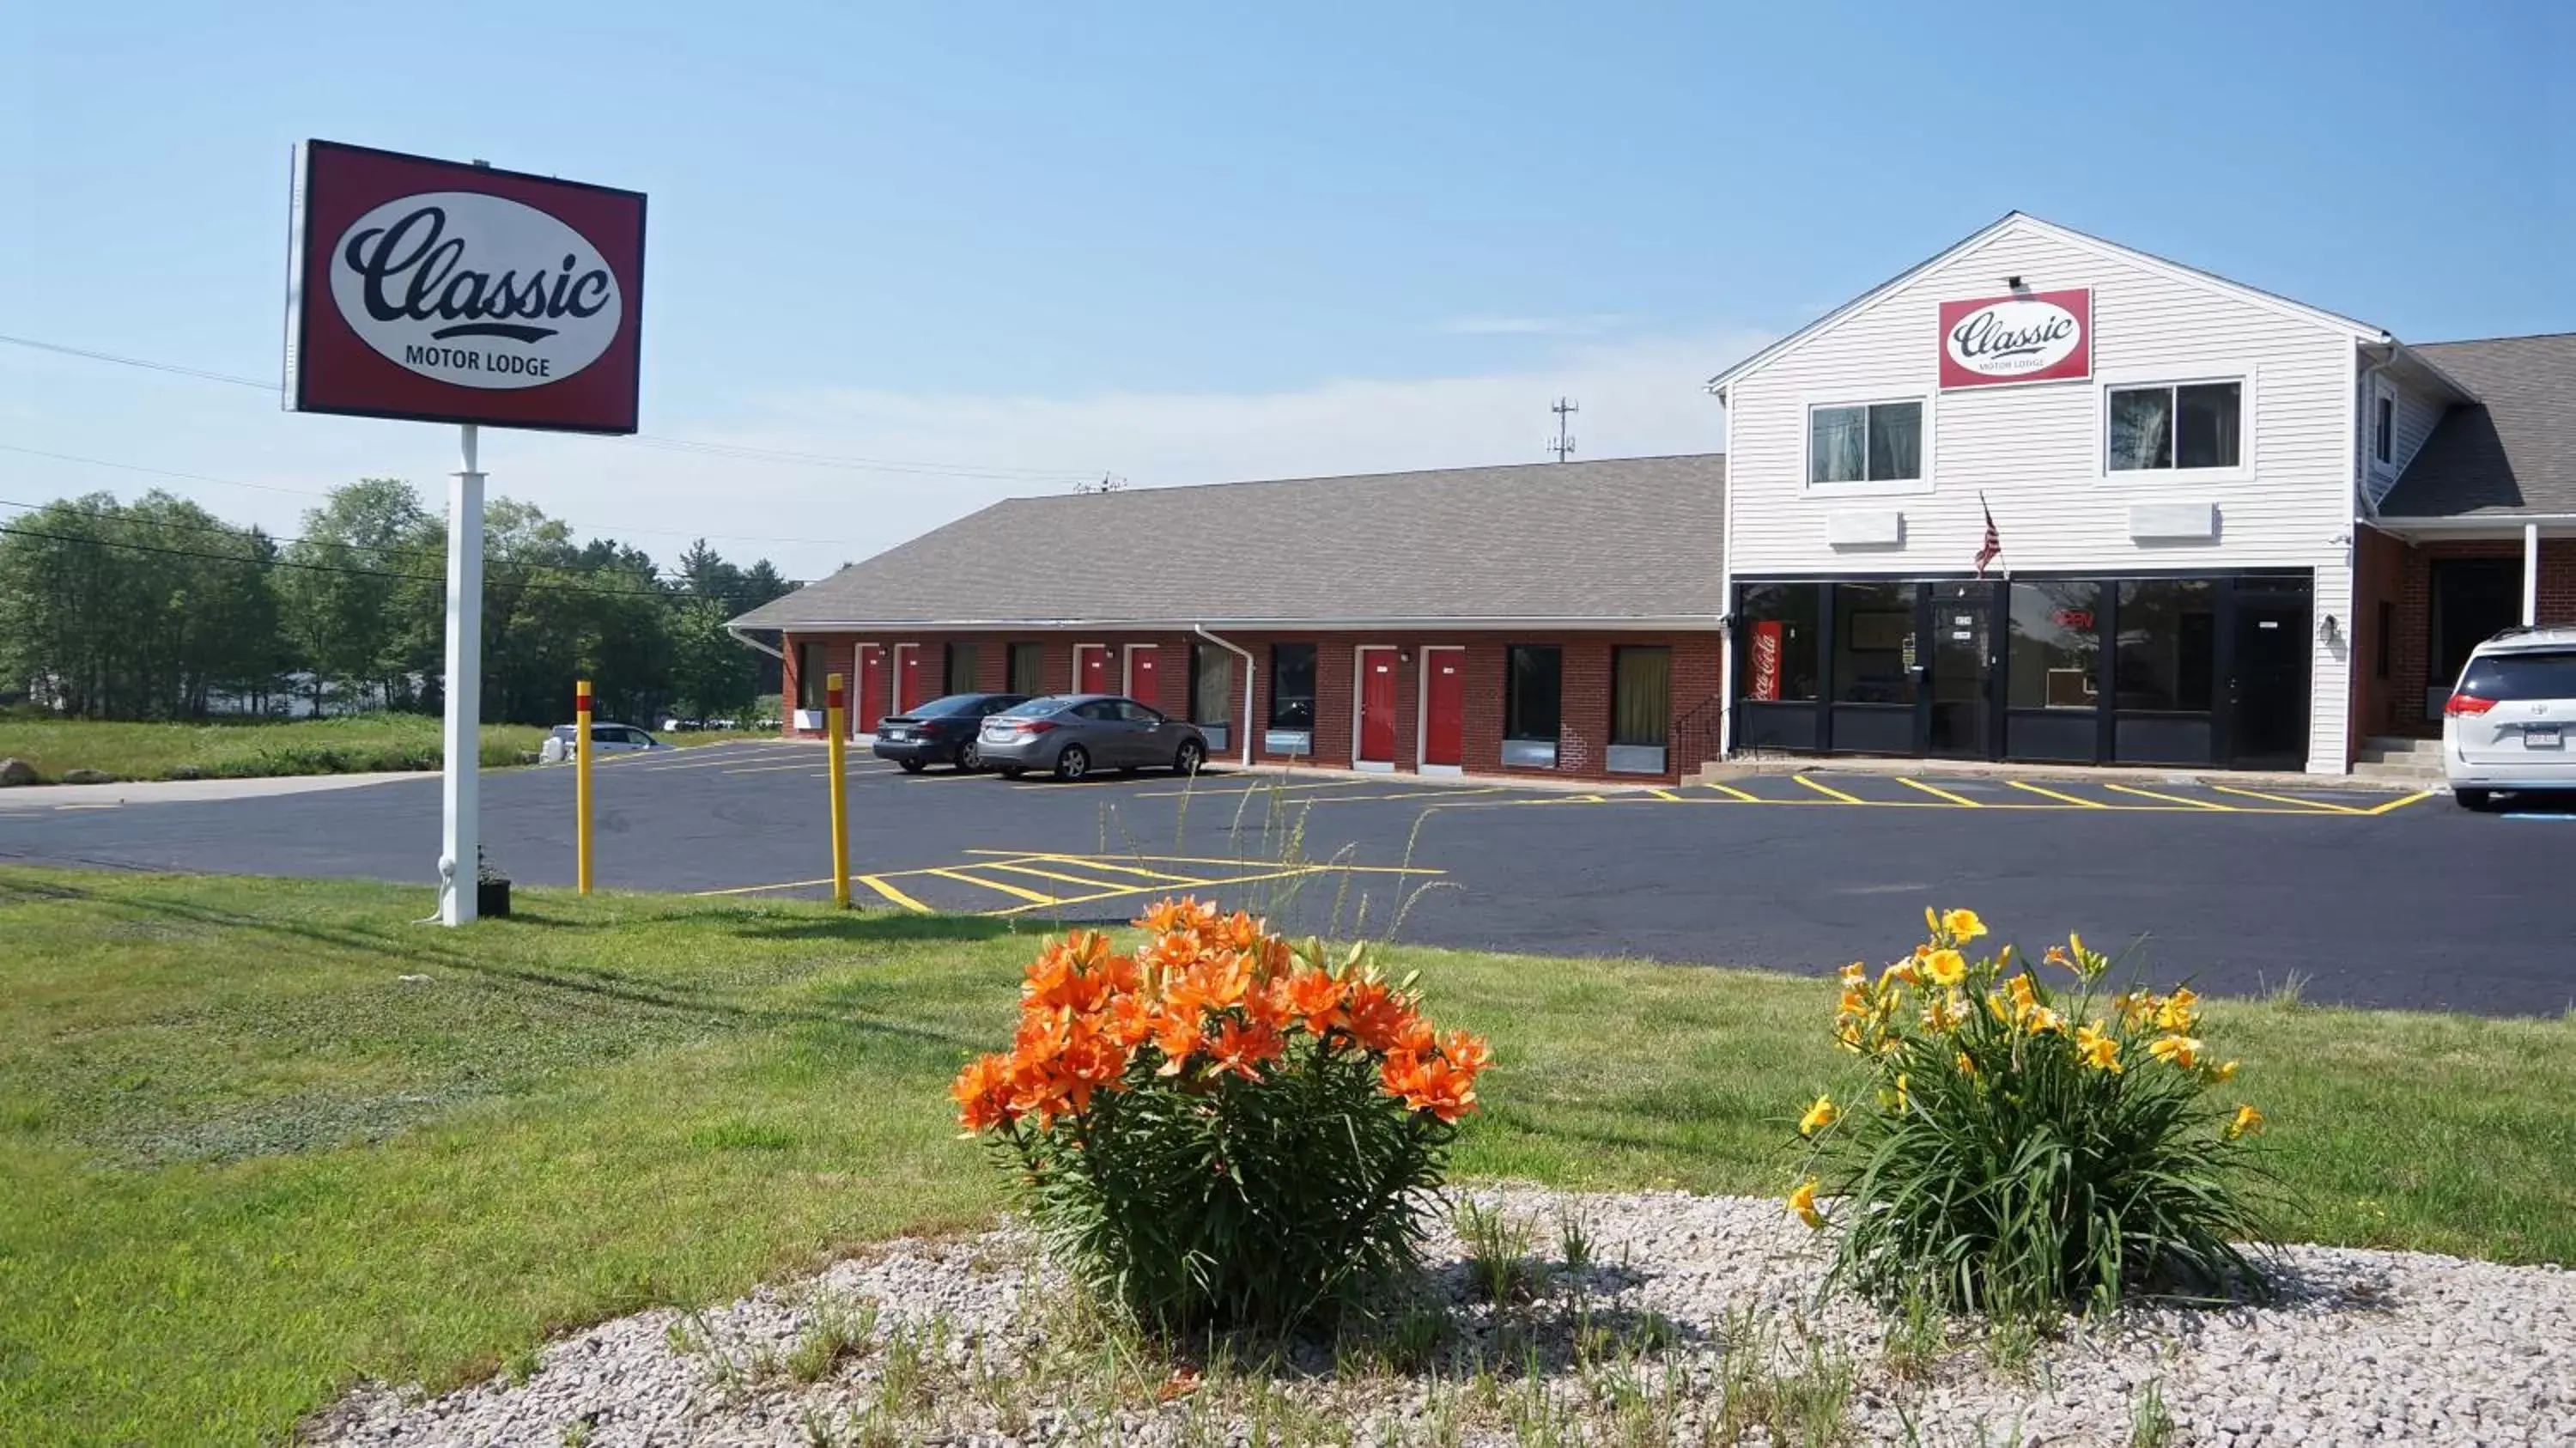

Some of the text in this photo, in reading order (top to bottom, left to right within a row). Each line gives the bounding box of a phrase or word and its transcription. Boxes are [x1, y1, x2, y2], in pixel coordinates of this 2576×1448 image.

[345, 206, 610, 322] Classic
[1953, 311, 2073, 357] Classic
[406, 344, 550, 377] MOTOR LODGE
[2014, 359, 2044, 368] LODGE
